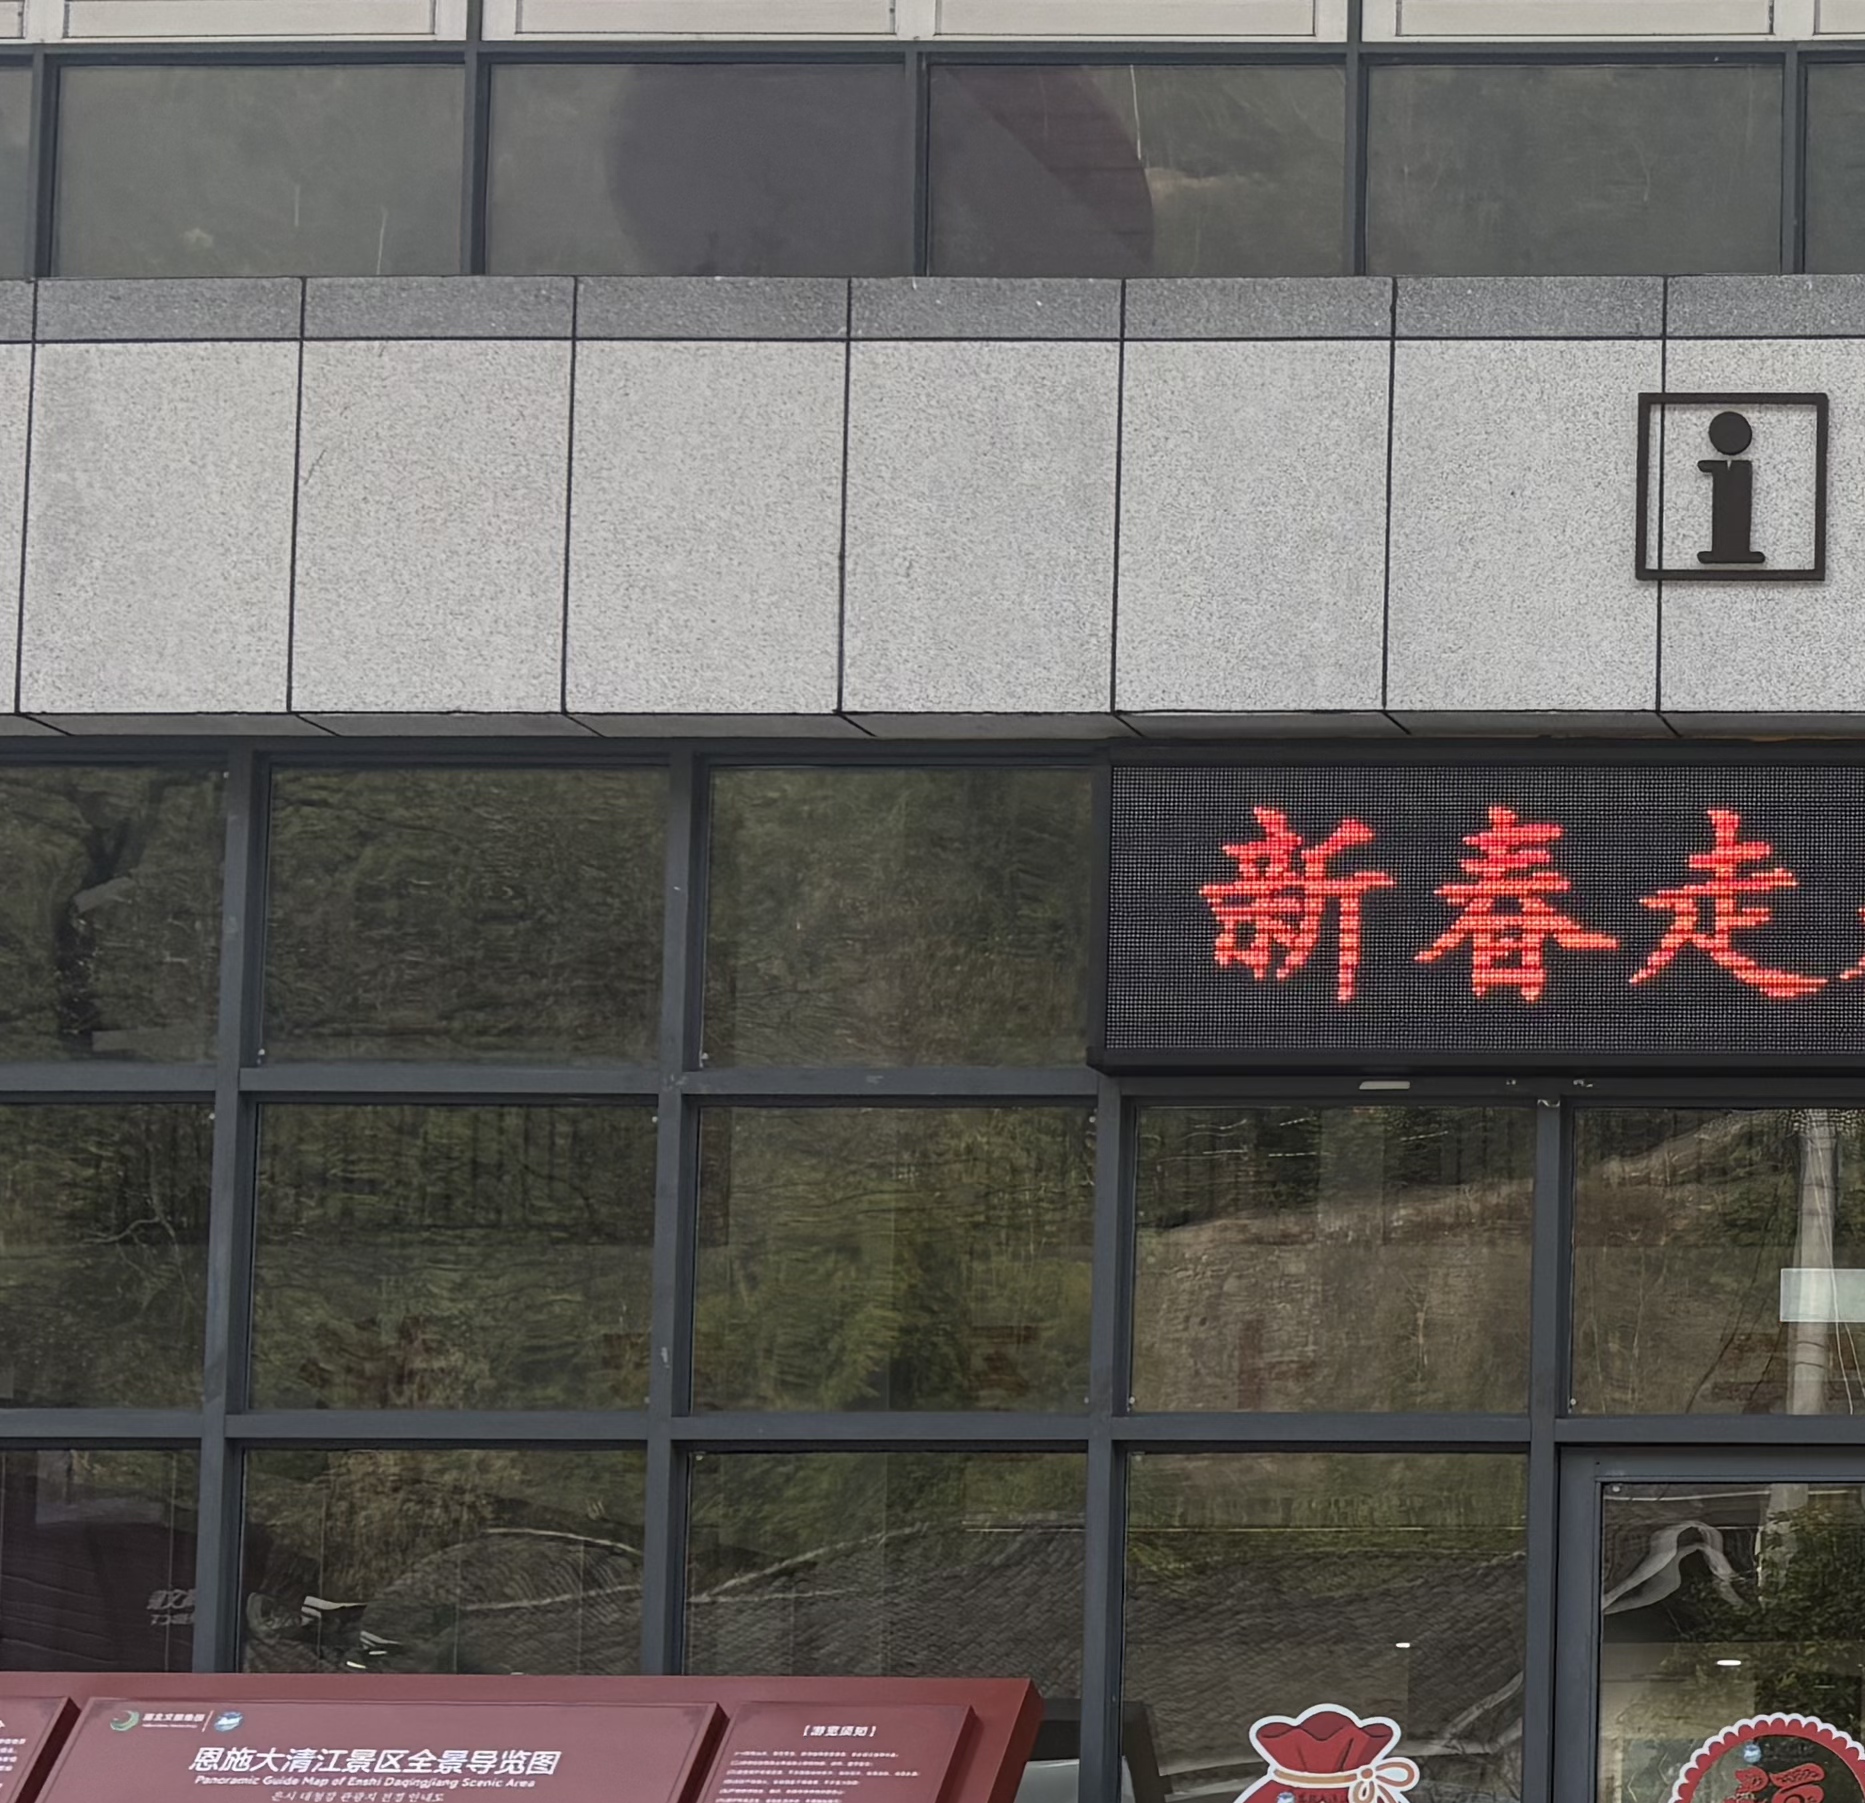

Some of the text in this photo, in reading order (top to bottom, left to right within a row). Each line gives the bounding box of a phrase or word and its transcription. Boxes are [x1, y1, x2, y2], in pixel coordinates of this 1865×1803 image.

[188, 1746, 562, 1776] 恩施大清江景区全景导览图
[195, 1774, 536, 1791] Panoramic Guide Map of Enshi Daqingjiang Scenic Area
